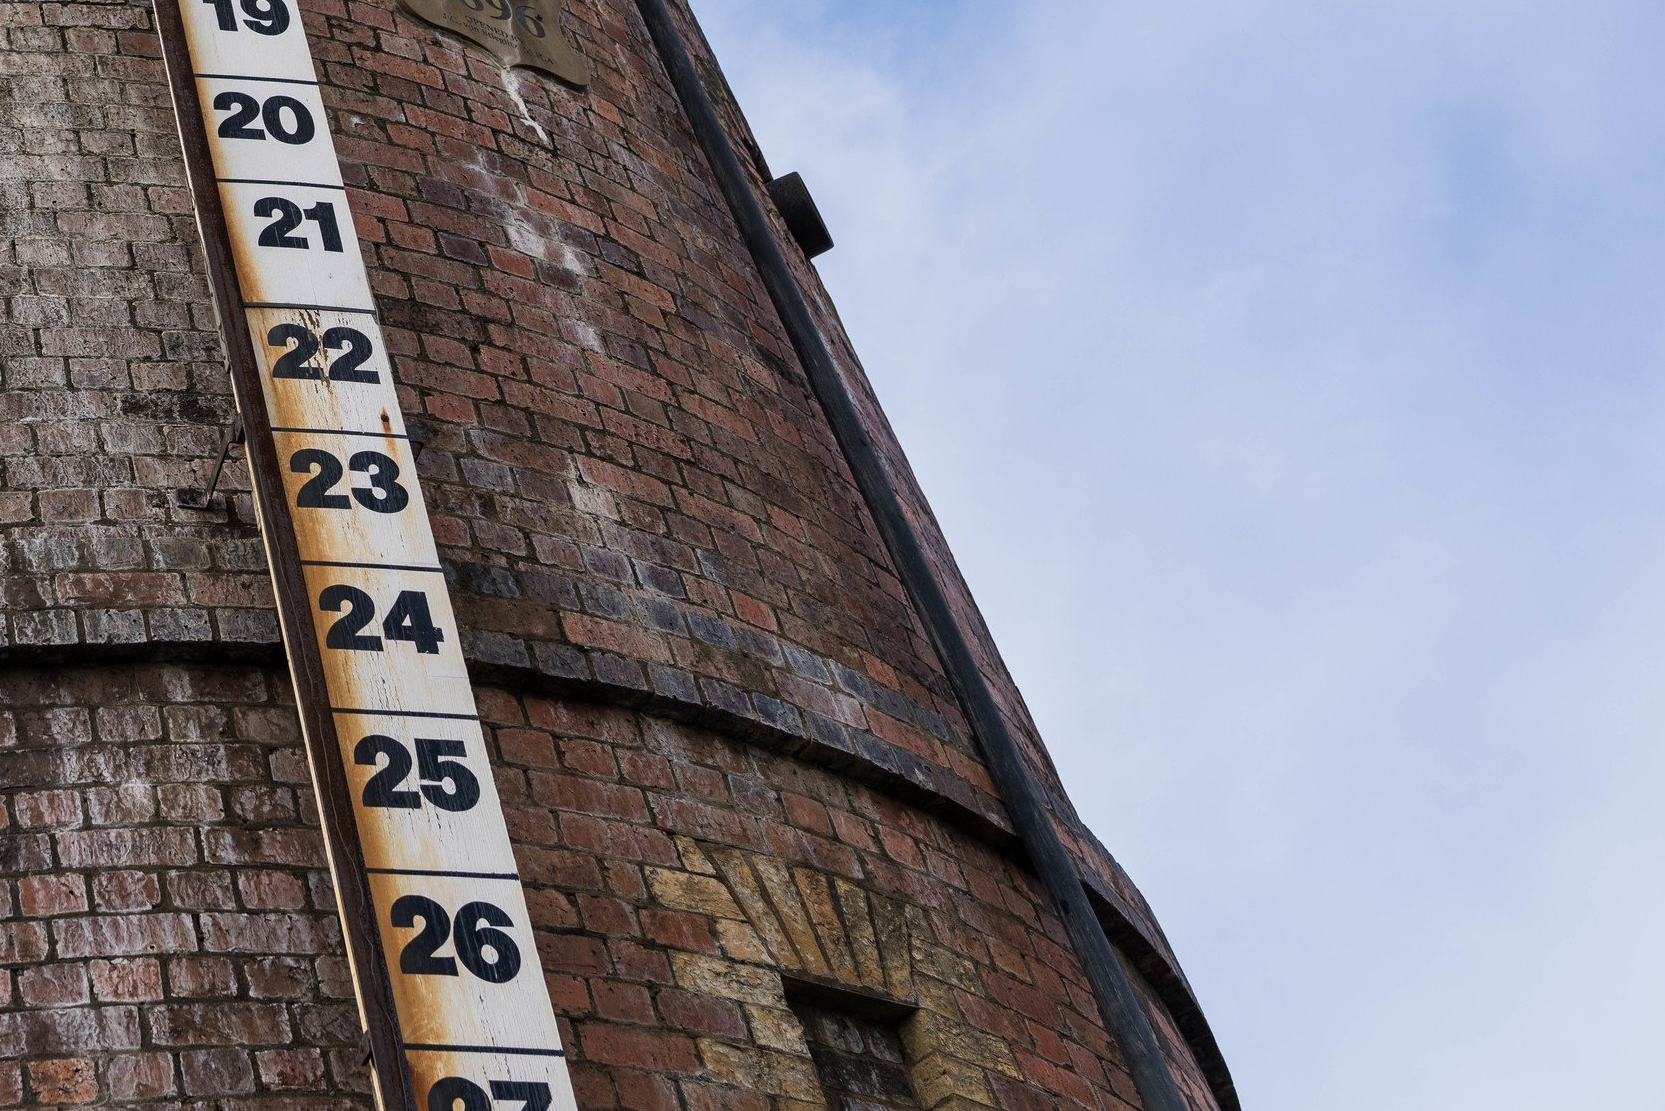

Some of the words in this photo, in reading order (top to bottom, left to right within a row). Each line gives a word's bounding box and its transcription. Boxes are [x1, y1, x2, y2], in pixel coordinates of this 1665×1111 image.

[213, 91, 315, 145] 20
[253, 196, 344, 252] 21
[267, 324, 380, 384] 22
[290, 449, 409, 514] 23
[319, 585, 444, 654] 24
[354, 735, 481, 812] 25
[391, 895, 522, 984] 26
